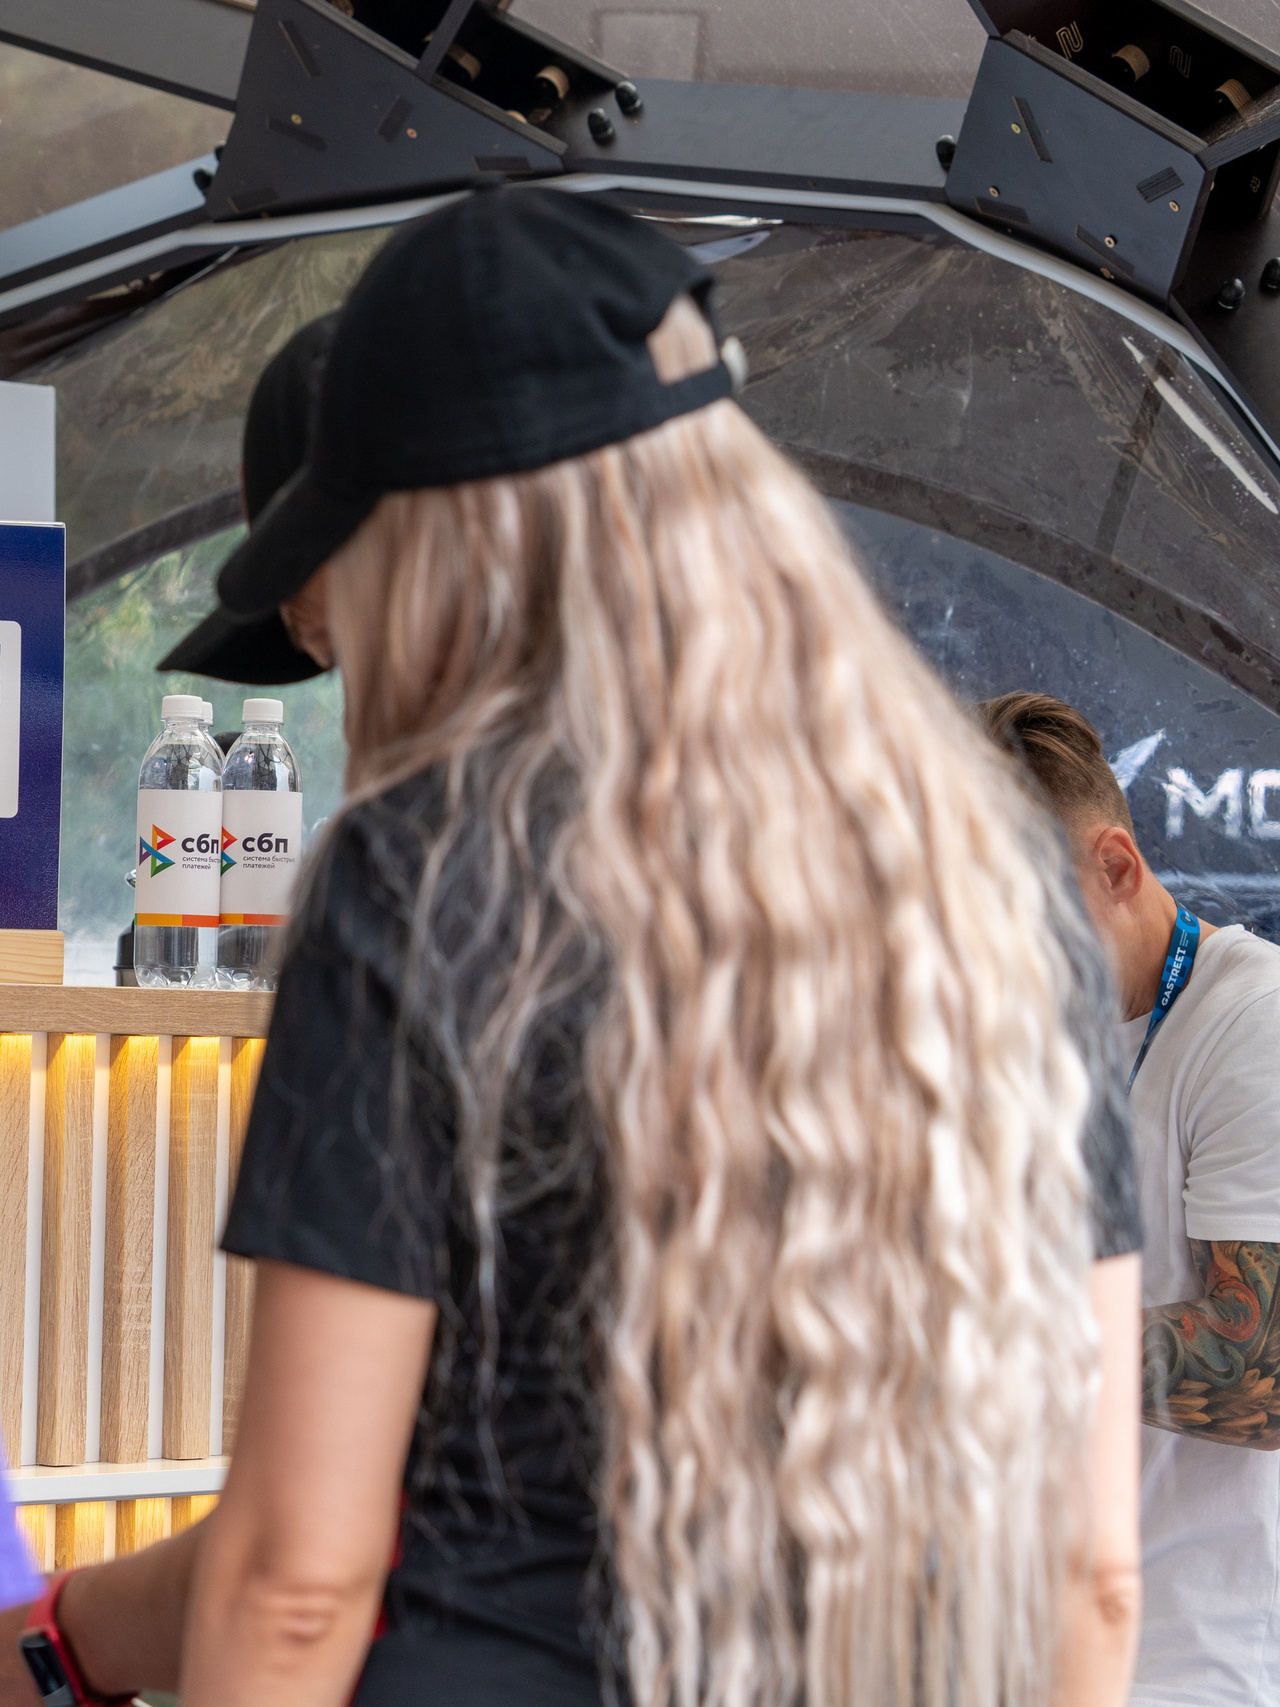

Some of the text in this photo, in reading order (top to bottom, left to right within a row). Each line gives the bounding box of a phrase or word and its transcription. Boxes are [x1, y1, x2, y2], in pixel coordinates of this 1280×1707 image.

[181, 833, 219, 854] сбп
[241, 833, 289, 854] сбп
[1161, 947, 1186, 1006] GASTREET
